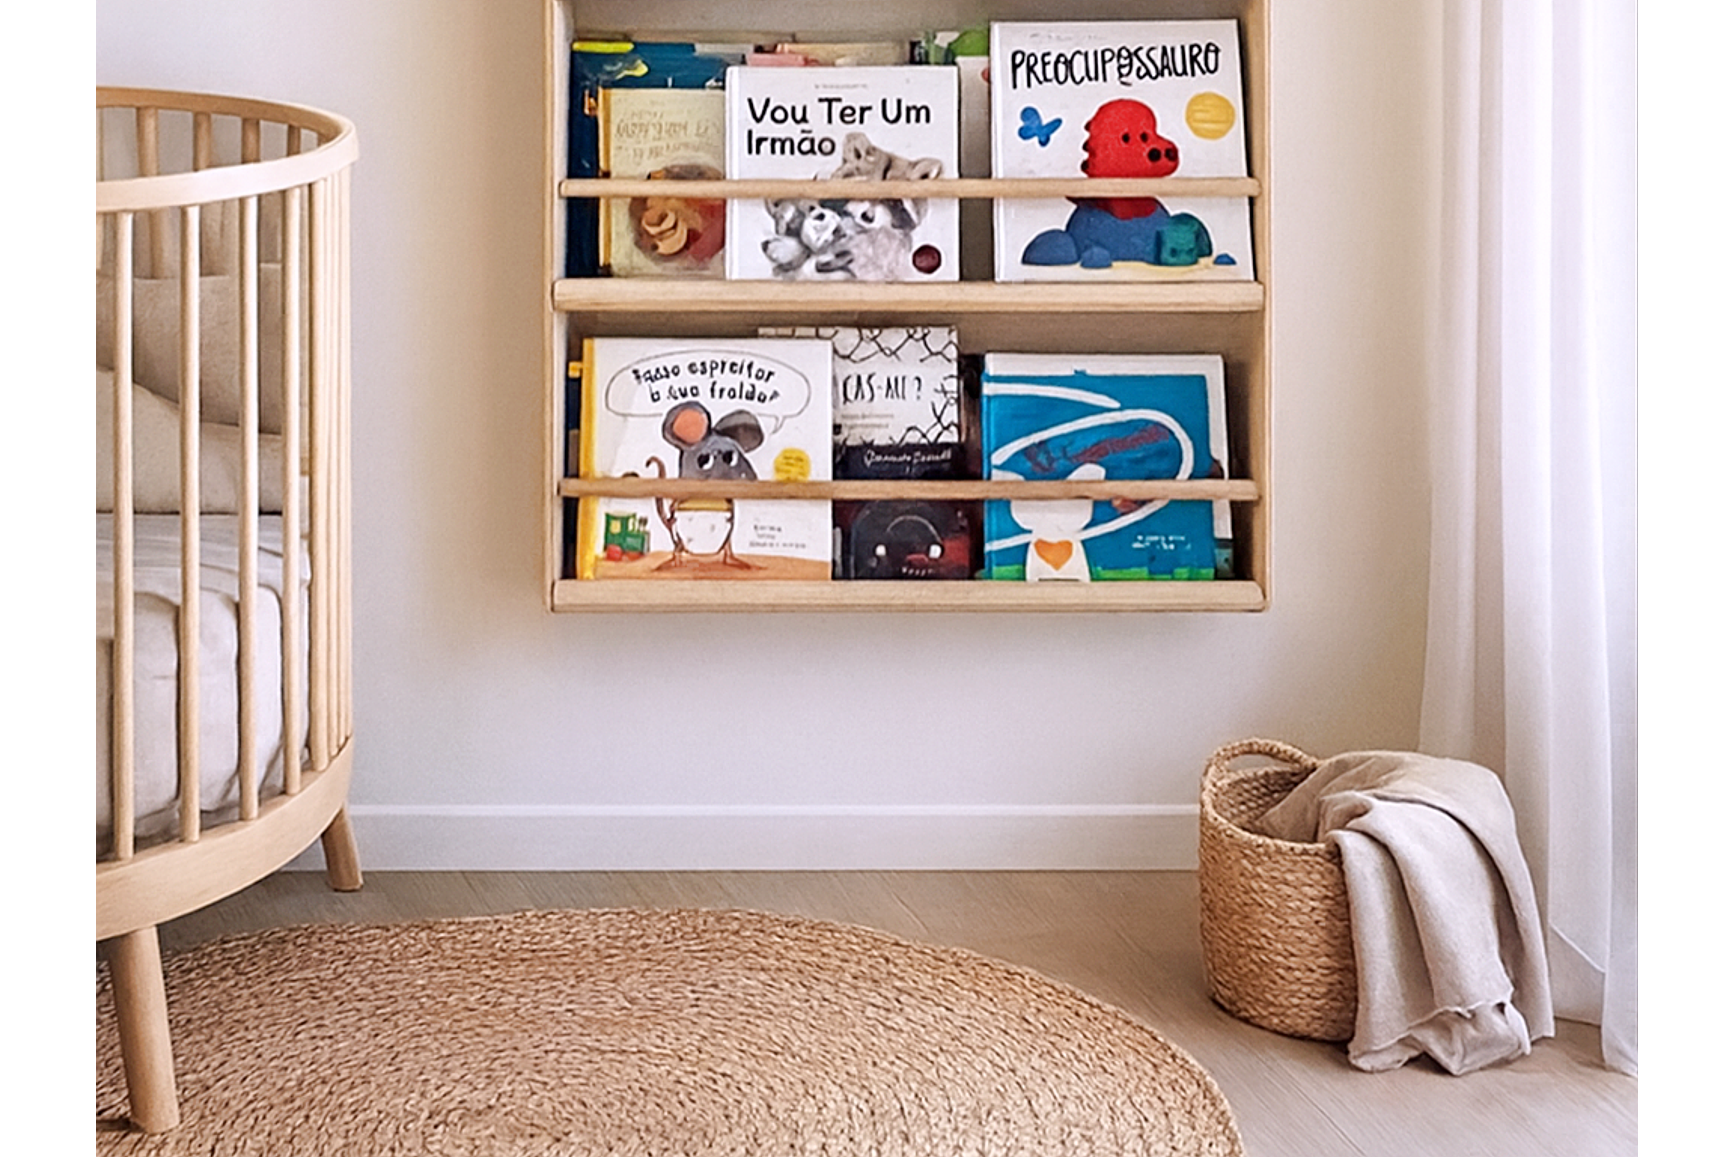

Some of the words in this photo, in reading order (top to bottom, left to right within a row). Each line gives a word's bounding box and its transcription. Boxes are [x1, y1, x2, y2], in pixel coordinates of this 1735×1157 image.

[747, 96, 809, 125] Vou
[817, 96, 873, 125] Ter
[881, 97, 931, 125] Um
[747, 128, 836, 156] Irmão
